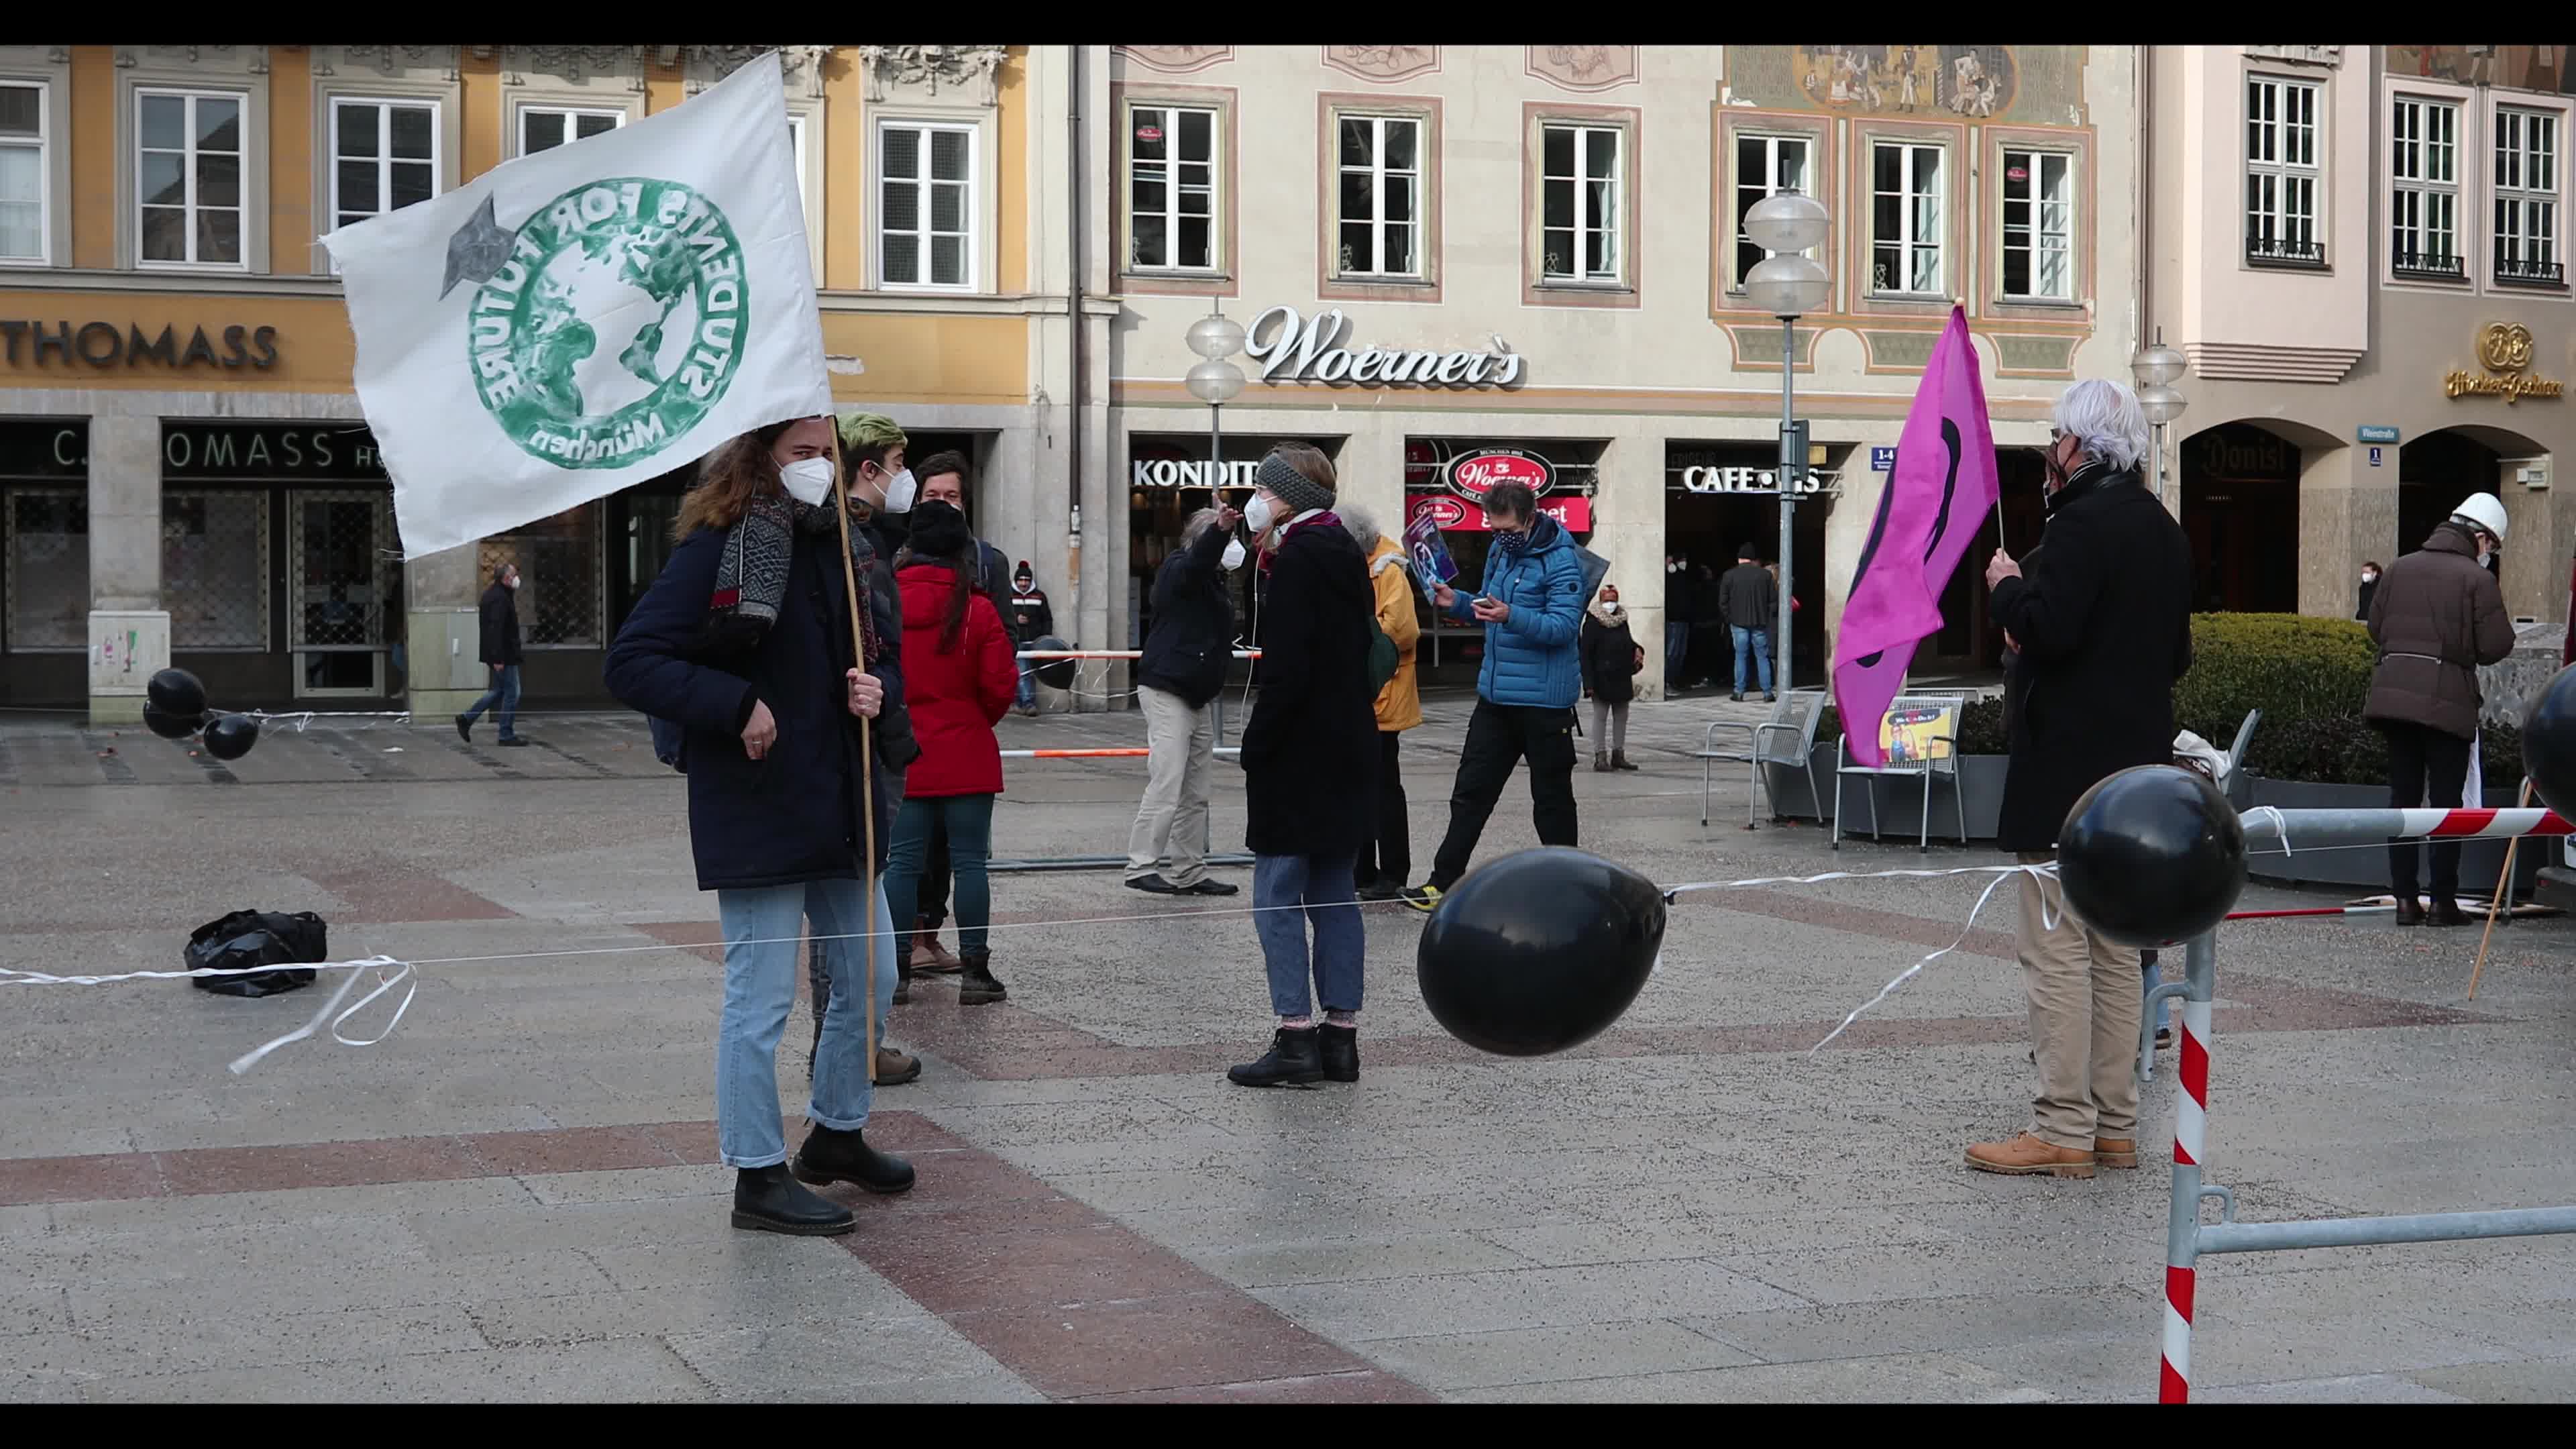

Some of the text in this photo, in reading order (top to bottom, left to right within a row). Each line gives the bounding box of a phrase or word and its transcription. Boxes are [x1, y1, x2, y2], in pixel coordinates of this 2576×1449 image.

[0, 321, 278, 368] THOMASS
[1246, 305, 1519, 385] Woerner's
[1134, 460, 1258, 486] KONDIT
